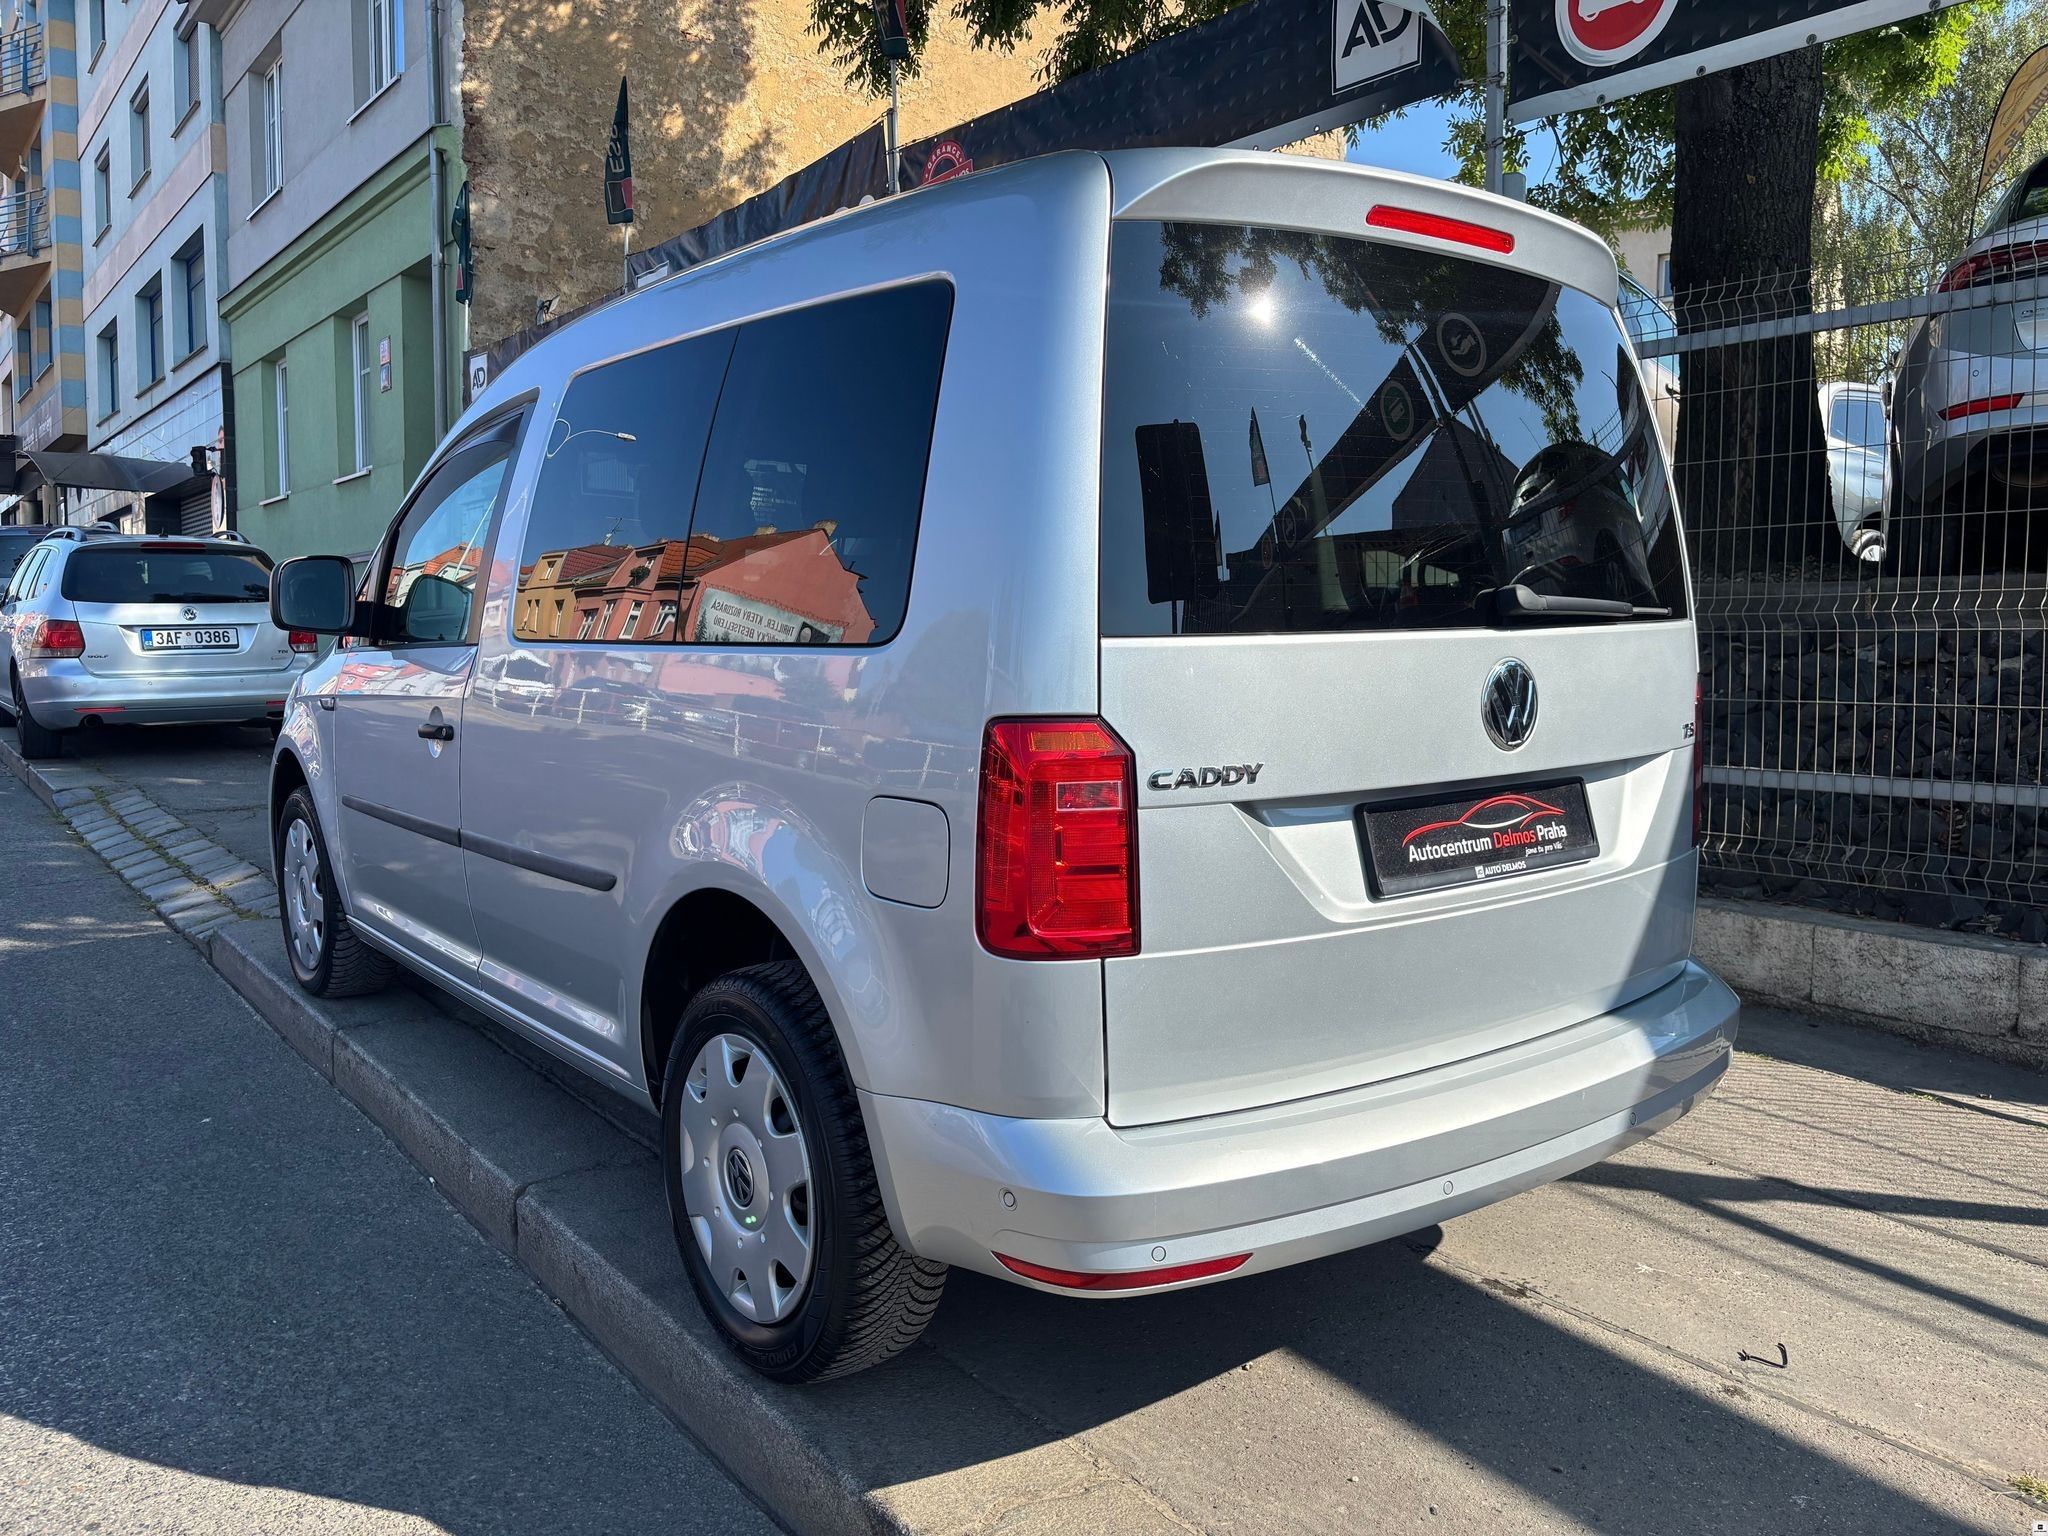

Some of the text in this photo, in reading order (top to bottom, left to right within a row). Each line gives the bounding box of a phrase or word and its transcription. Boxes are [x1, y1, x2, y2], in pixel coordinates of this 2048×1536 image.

[1341, 0, 1413, 59] AD
[2004, 128, 2022, 149] SE
[472, 366, 486, 391] AD
[156, 631, 231, 645] 3AF 0386
[1147, 762, 1264, 791] CADDY
[1408, 822, 1568, 863] Autocentrum Delmos Praha
[1485, 861, 1527, 875] AUTO DELMOS
